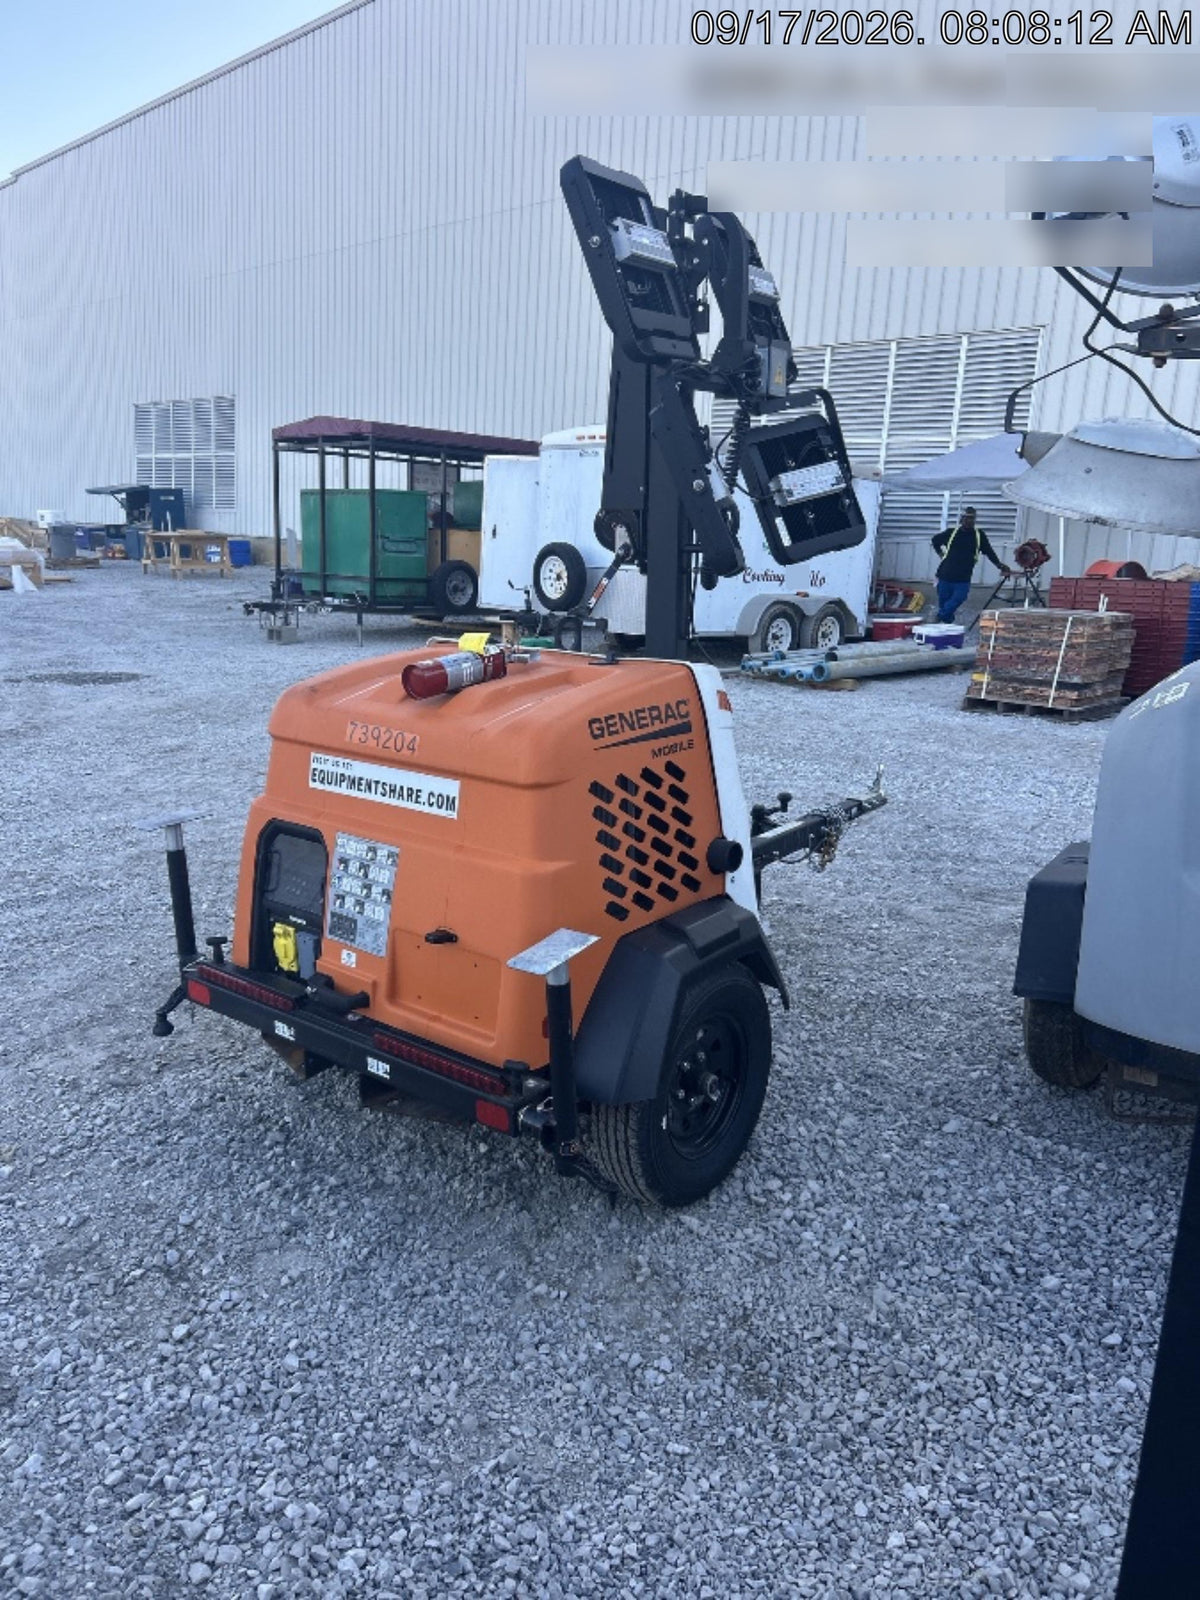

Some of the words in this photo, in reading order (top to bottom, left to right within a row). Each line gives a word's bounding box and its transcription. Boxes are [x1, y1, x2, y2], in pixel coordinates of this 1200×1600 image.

[349, 721, 418, 753] 739204
[588, 699, 690, 740] GENERAC
[650, 739, 695, 759] MOBILE
[310, 767, 457, 812] EQUIPMENTSHARE.COM
